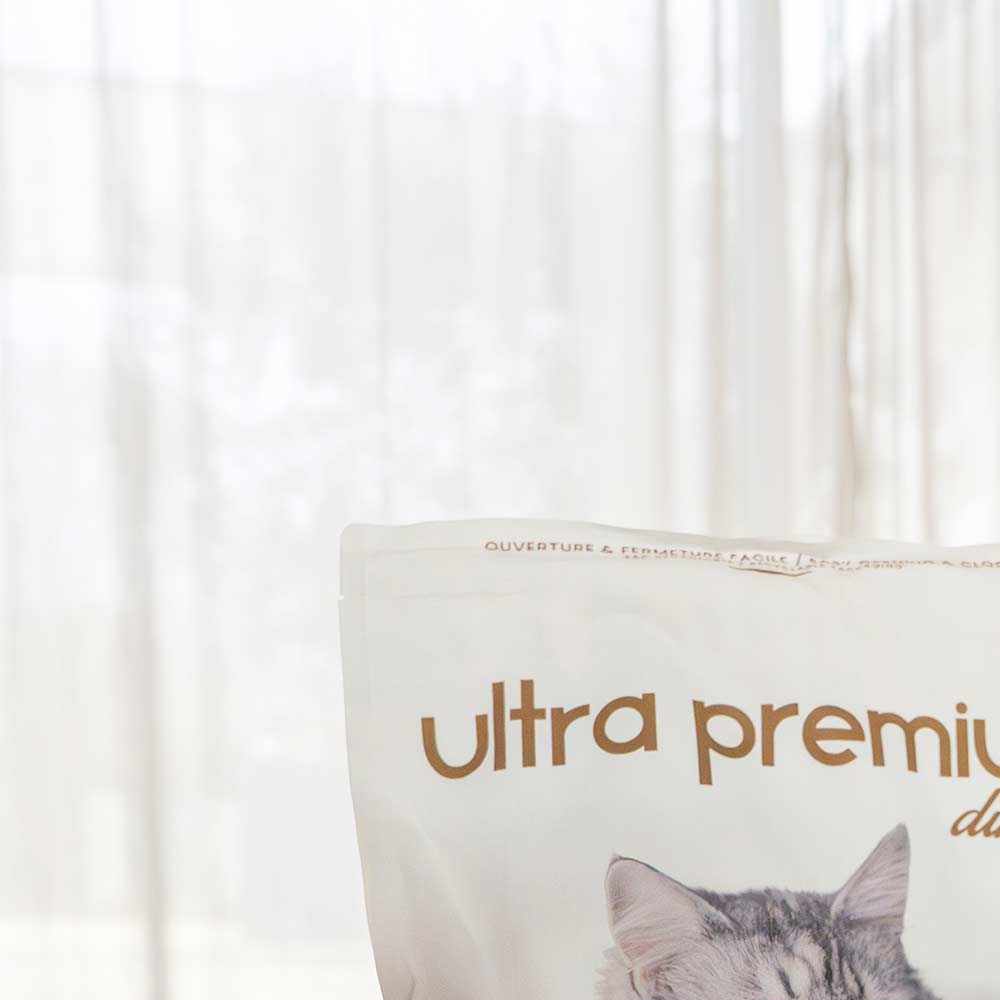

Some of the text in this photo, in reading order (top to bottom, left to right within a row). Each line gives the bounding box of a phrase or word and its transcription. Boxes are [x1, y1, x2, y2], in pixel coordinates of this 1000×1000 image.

[485, 541, 595, 553] OUVERTURE
[601, 545, 613, 553] &
[421, 679, 657, 780] ultra
